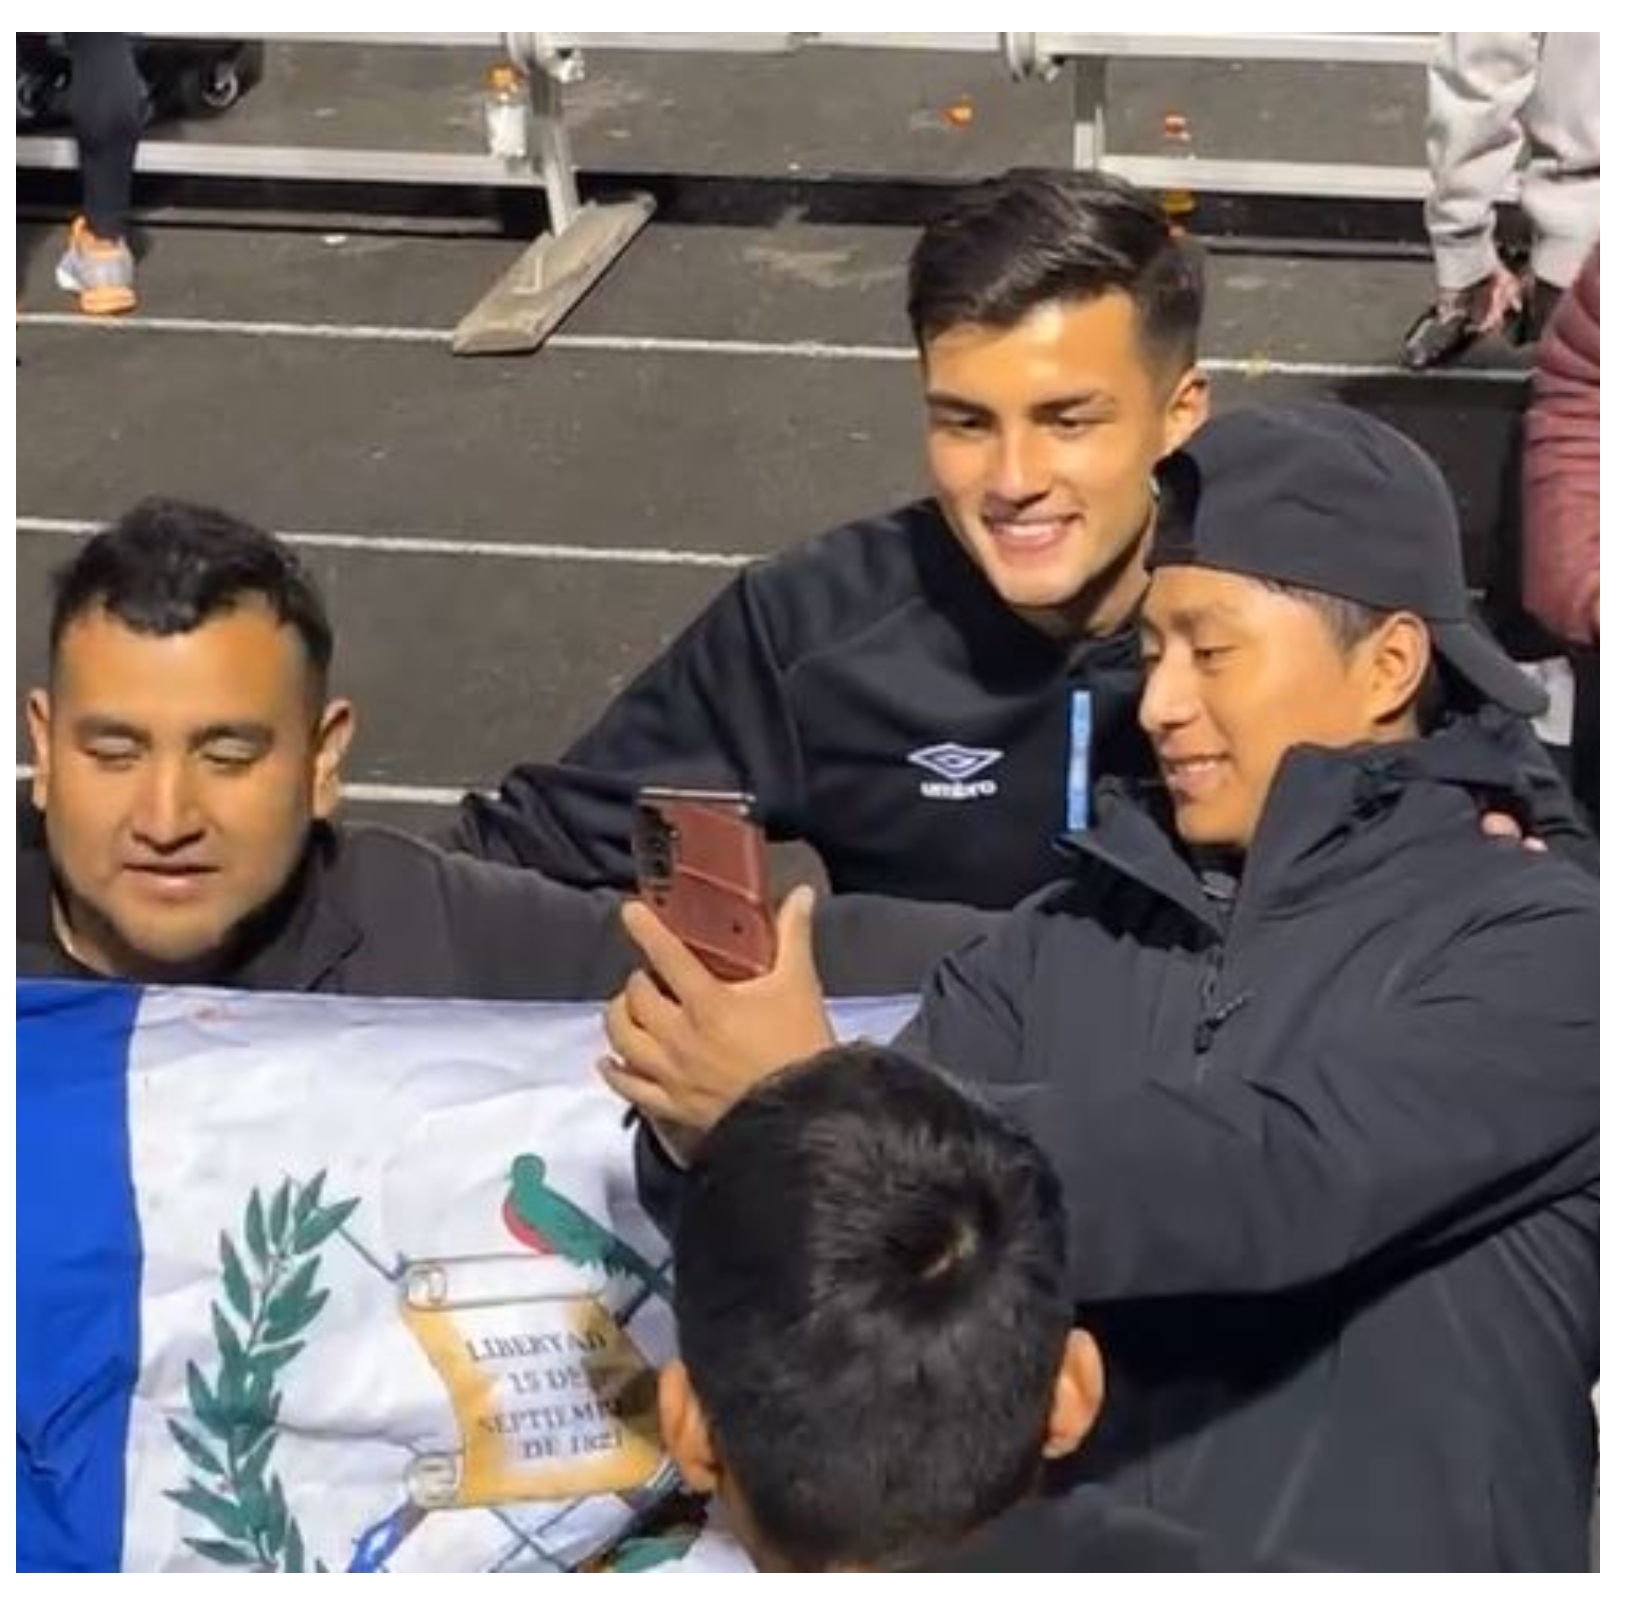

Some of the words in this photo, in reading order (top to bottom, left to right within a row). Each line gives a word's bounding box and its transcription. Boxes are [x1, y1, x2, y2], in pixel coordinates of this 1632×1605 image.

[920, 780, 998, 800] umbro
[466, 1330, 608, 1361] LIBERTAD
[508, 1371, 540, 1394] 15
[523, 1438, 556, 1458] DE
